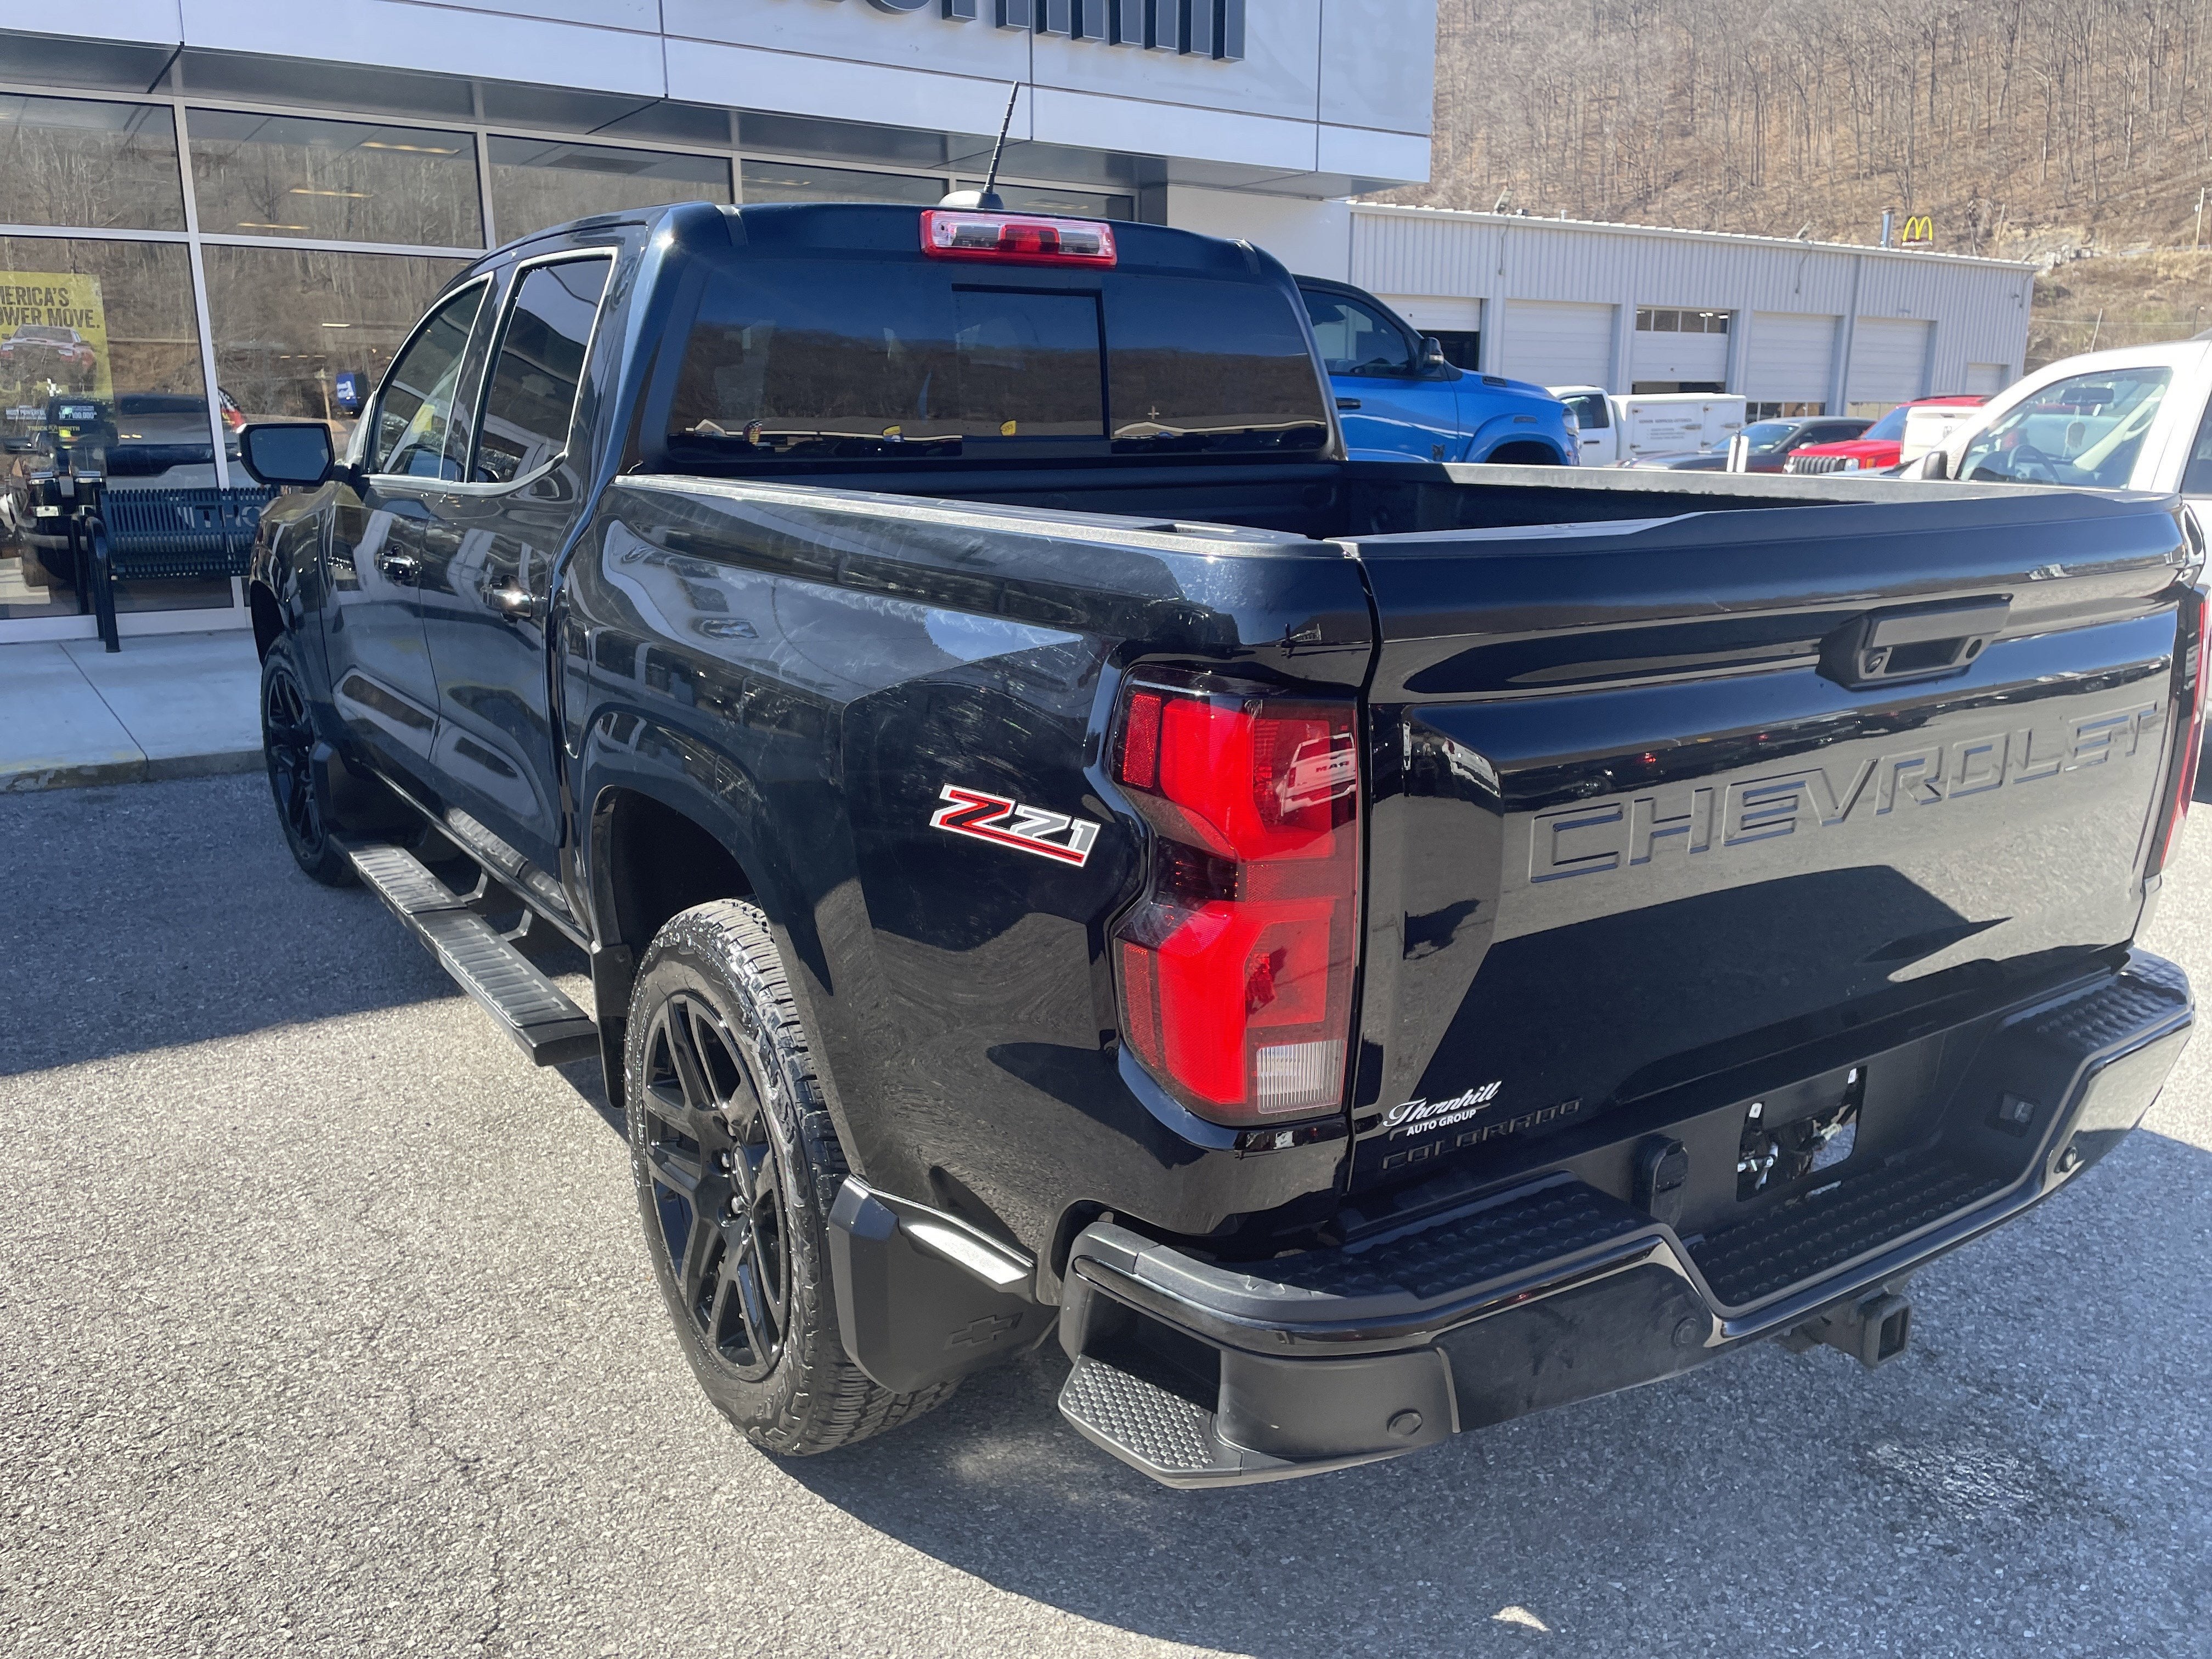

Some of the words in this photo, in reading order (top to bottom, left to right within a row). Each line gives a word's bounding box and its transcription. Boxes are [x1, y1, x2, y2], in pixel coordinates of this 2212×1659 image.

[47, 307, 100, 329] MOVE.
[1528, 699, 2158, 883] CHEVROLET
[929, 783, 1102, 868] Z71
[1382, 1097, 1583, 1170] COLORADO
[1383, 1080, 1503, 1127] Thornhill
[1406, 1119, 1437, 1137] AUTO
[1438, 1109, 1477, 1127] GROUP
